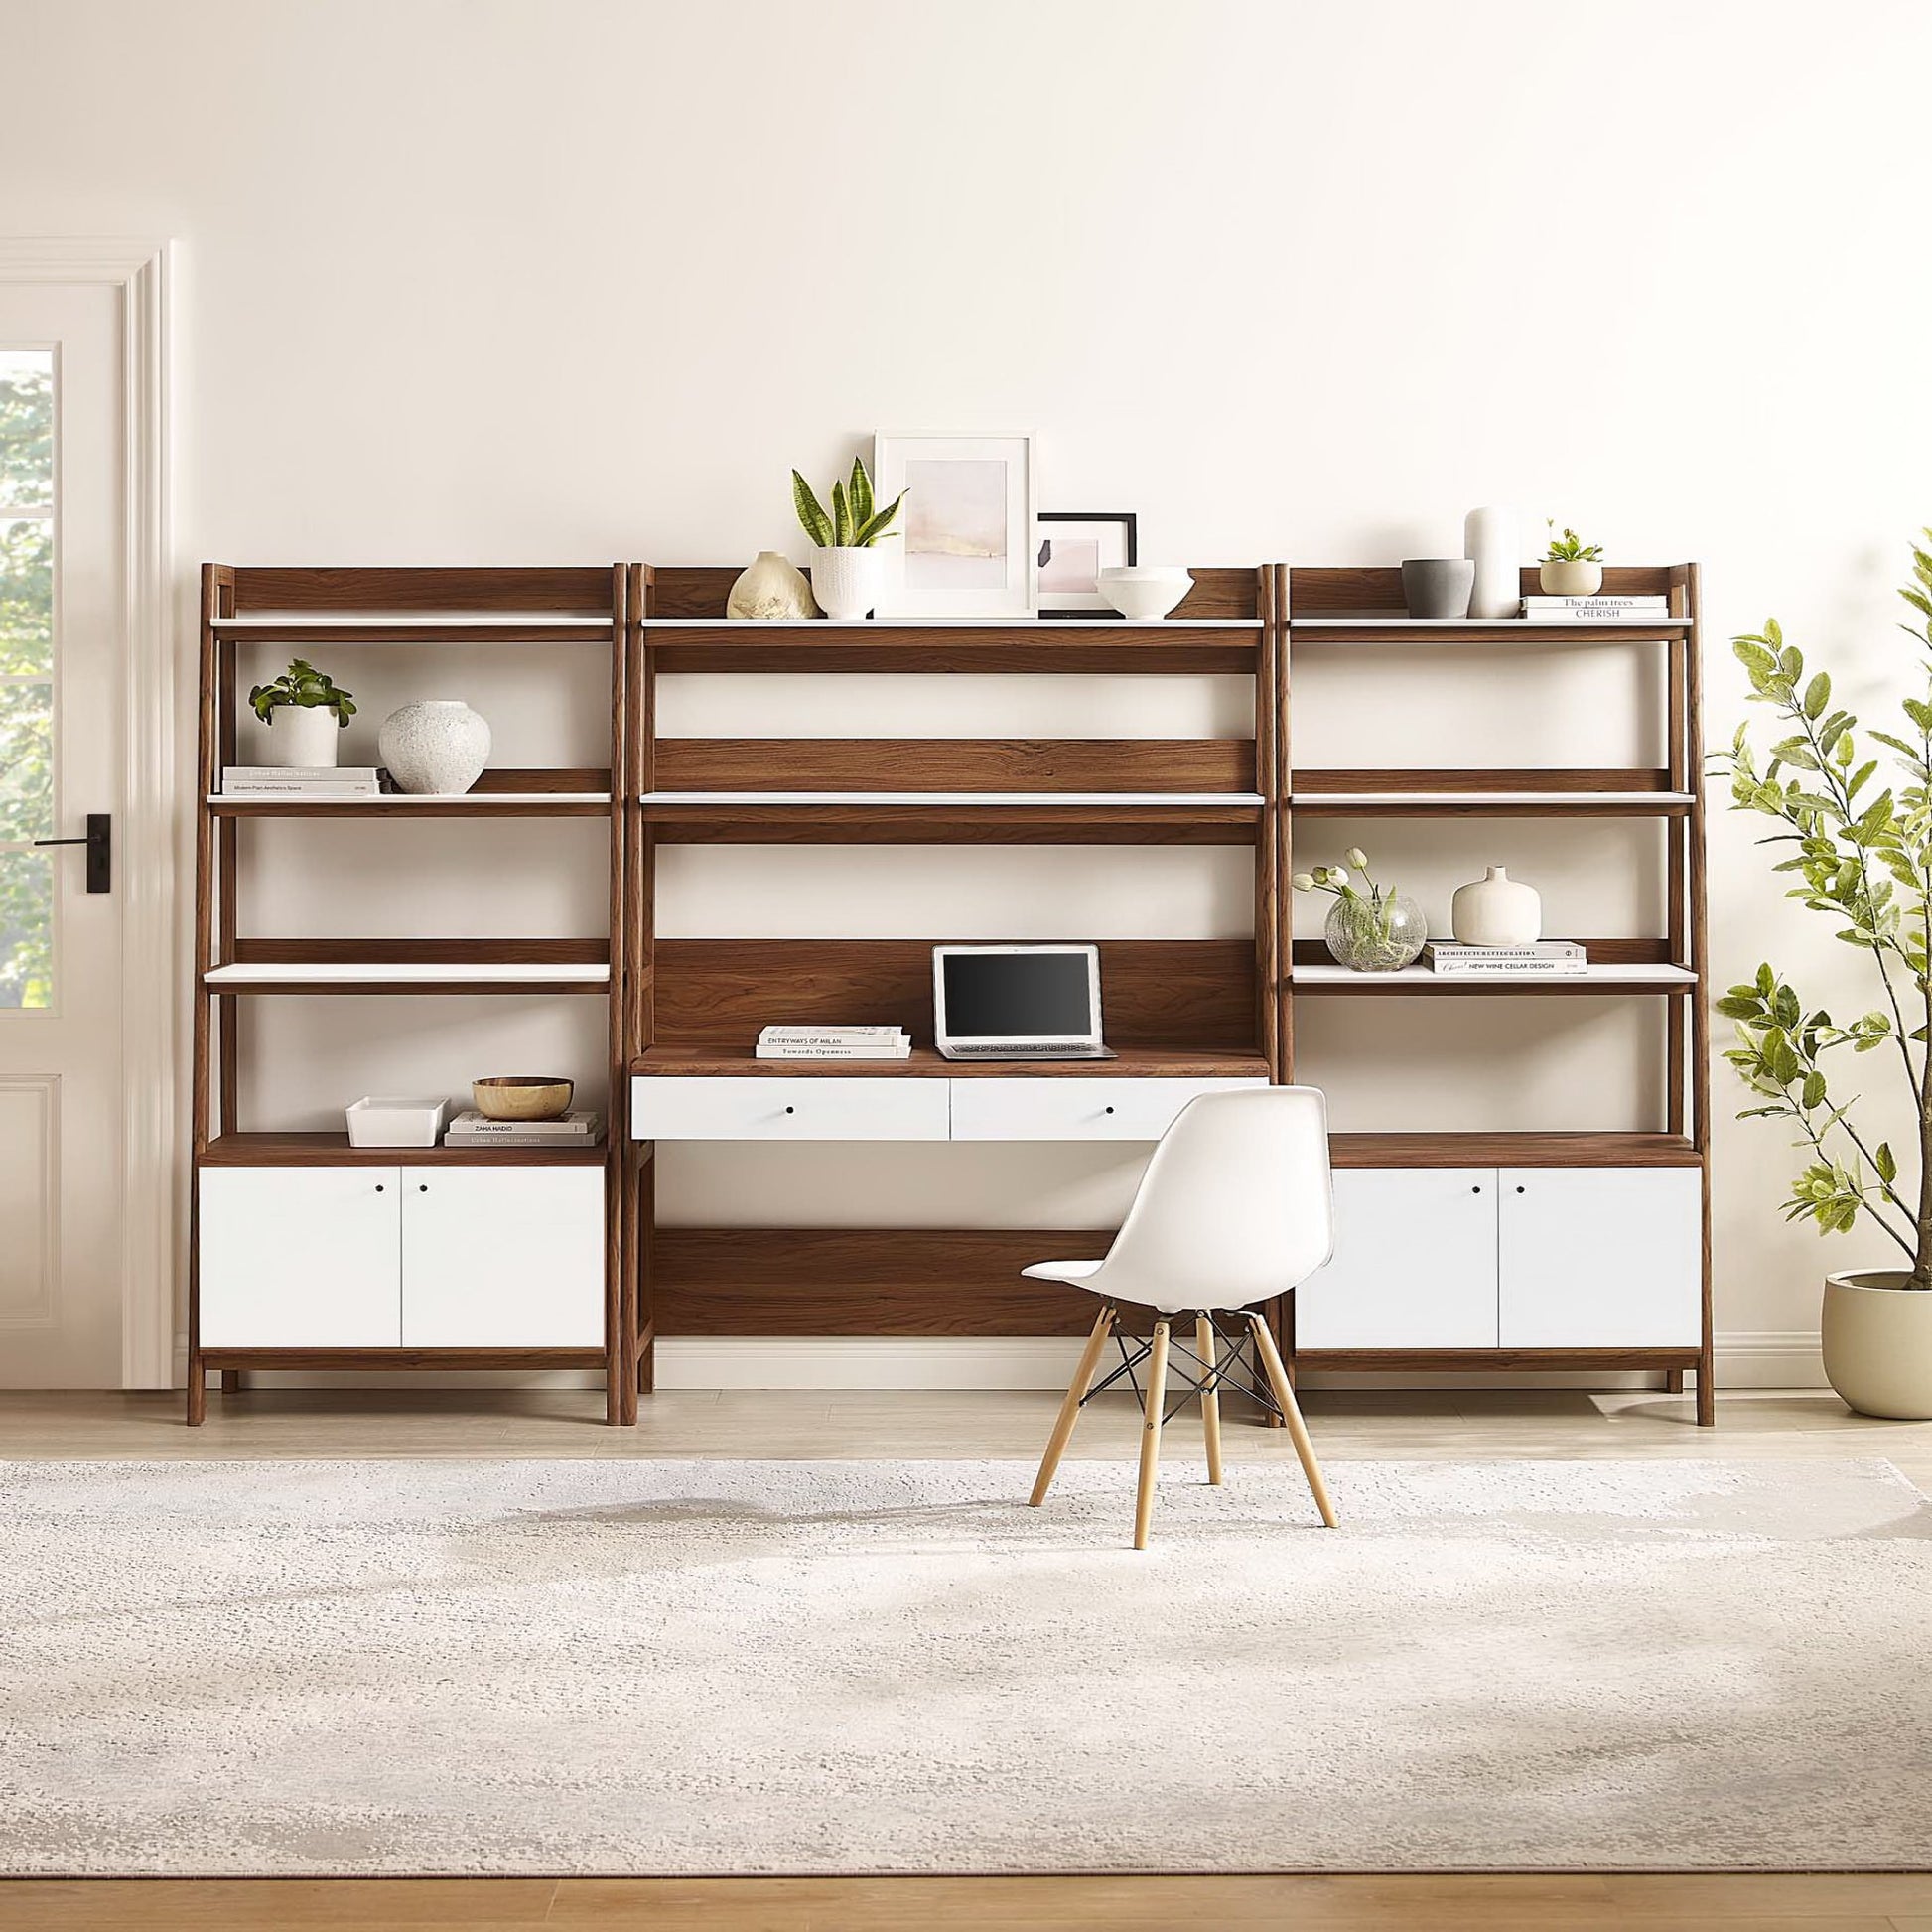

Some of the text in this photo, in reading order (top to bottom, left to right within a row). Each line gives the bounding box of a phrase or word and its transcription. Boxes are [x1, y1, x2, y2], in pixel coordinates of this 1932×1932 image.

[1564, 598, 1581, 607] The
[1584, 598, 1608, 609] palm
[1575, 609, 1620, 618] CHERISH
